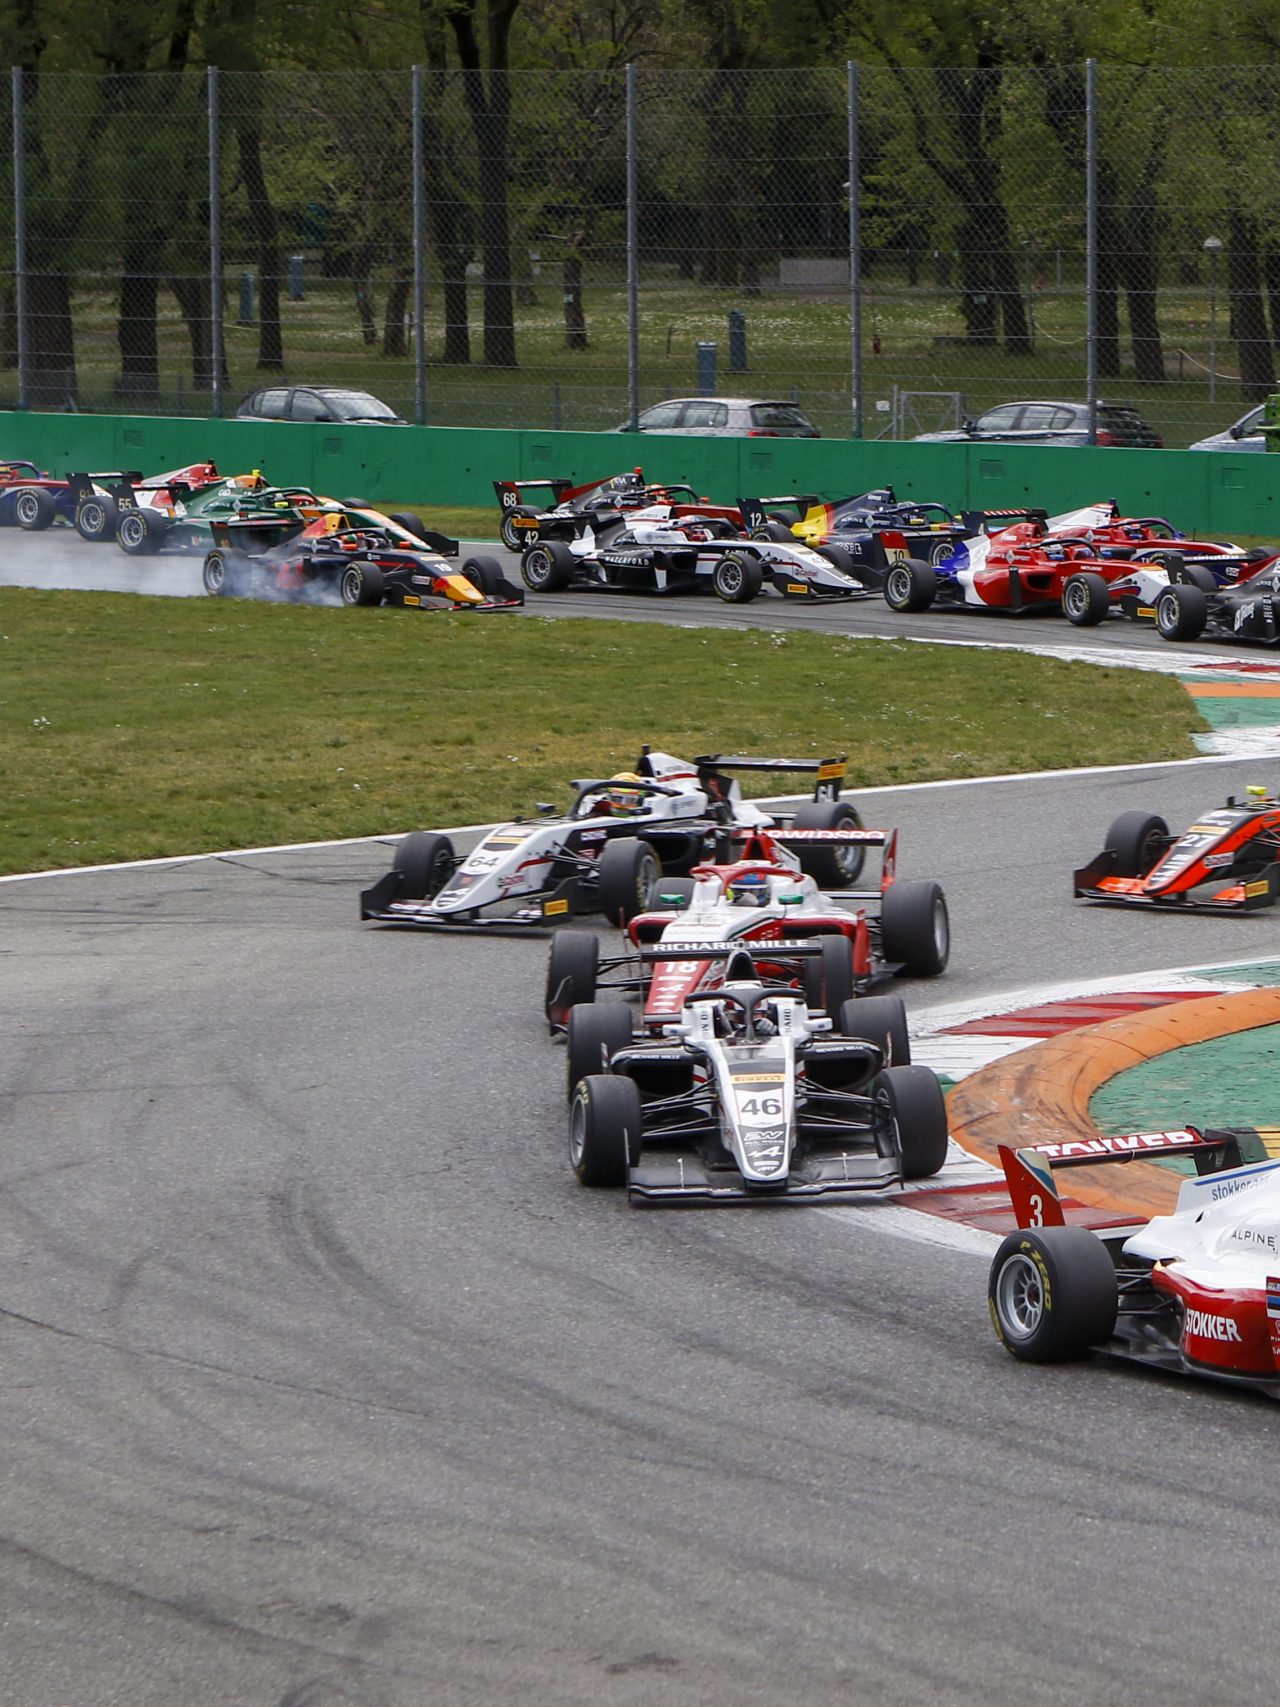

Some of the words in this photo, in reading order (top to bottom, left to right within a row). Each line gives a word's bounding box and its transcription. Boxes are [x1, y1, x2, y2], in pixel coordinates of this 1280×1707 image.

[503, 492, 516, 507] 68
[750, 512, 762, 527] 12
[525, 531, 539, 545] 42
[1177, 834, 1218, 847] 27
[469, 856, 500, 867] 64
[750, 939, 809, 948] MILLE
[665, 961, 698, 973] 18
[740, 1098, 782, 1115] 46
[1030, 1194, 1043, 1228] 3
[1232, 1230, 1275, 1248] ALPINE
[1185, 1307, 1243, 1342] STOKKER
